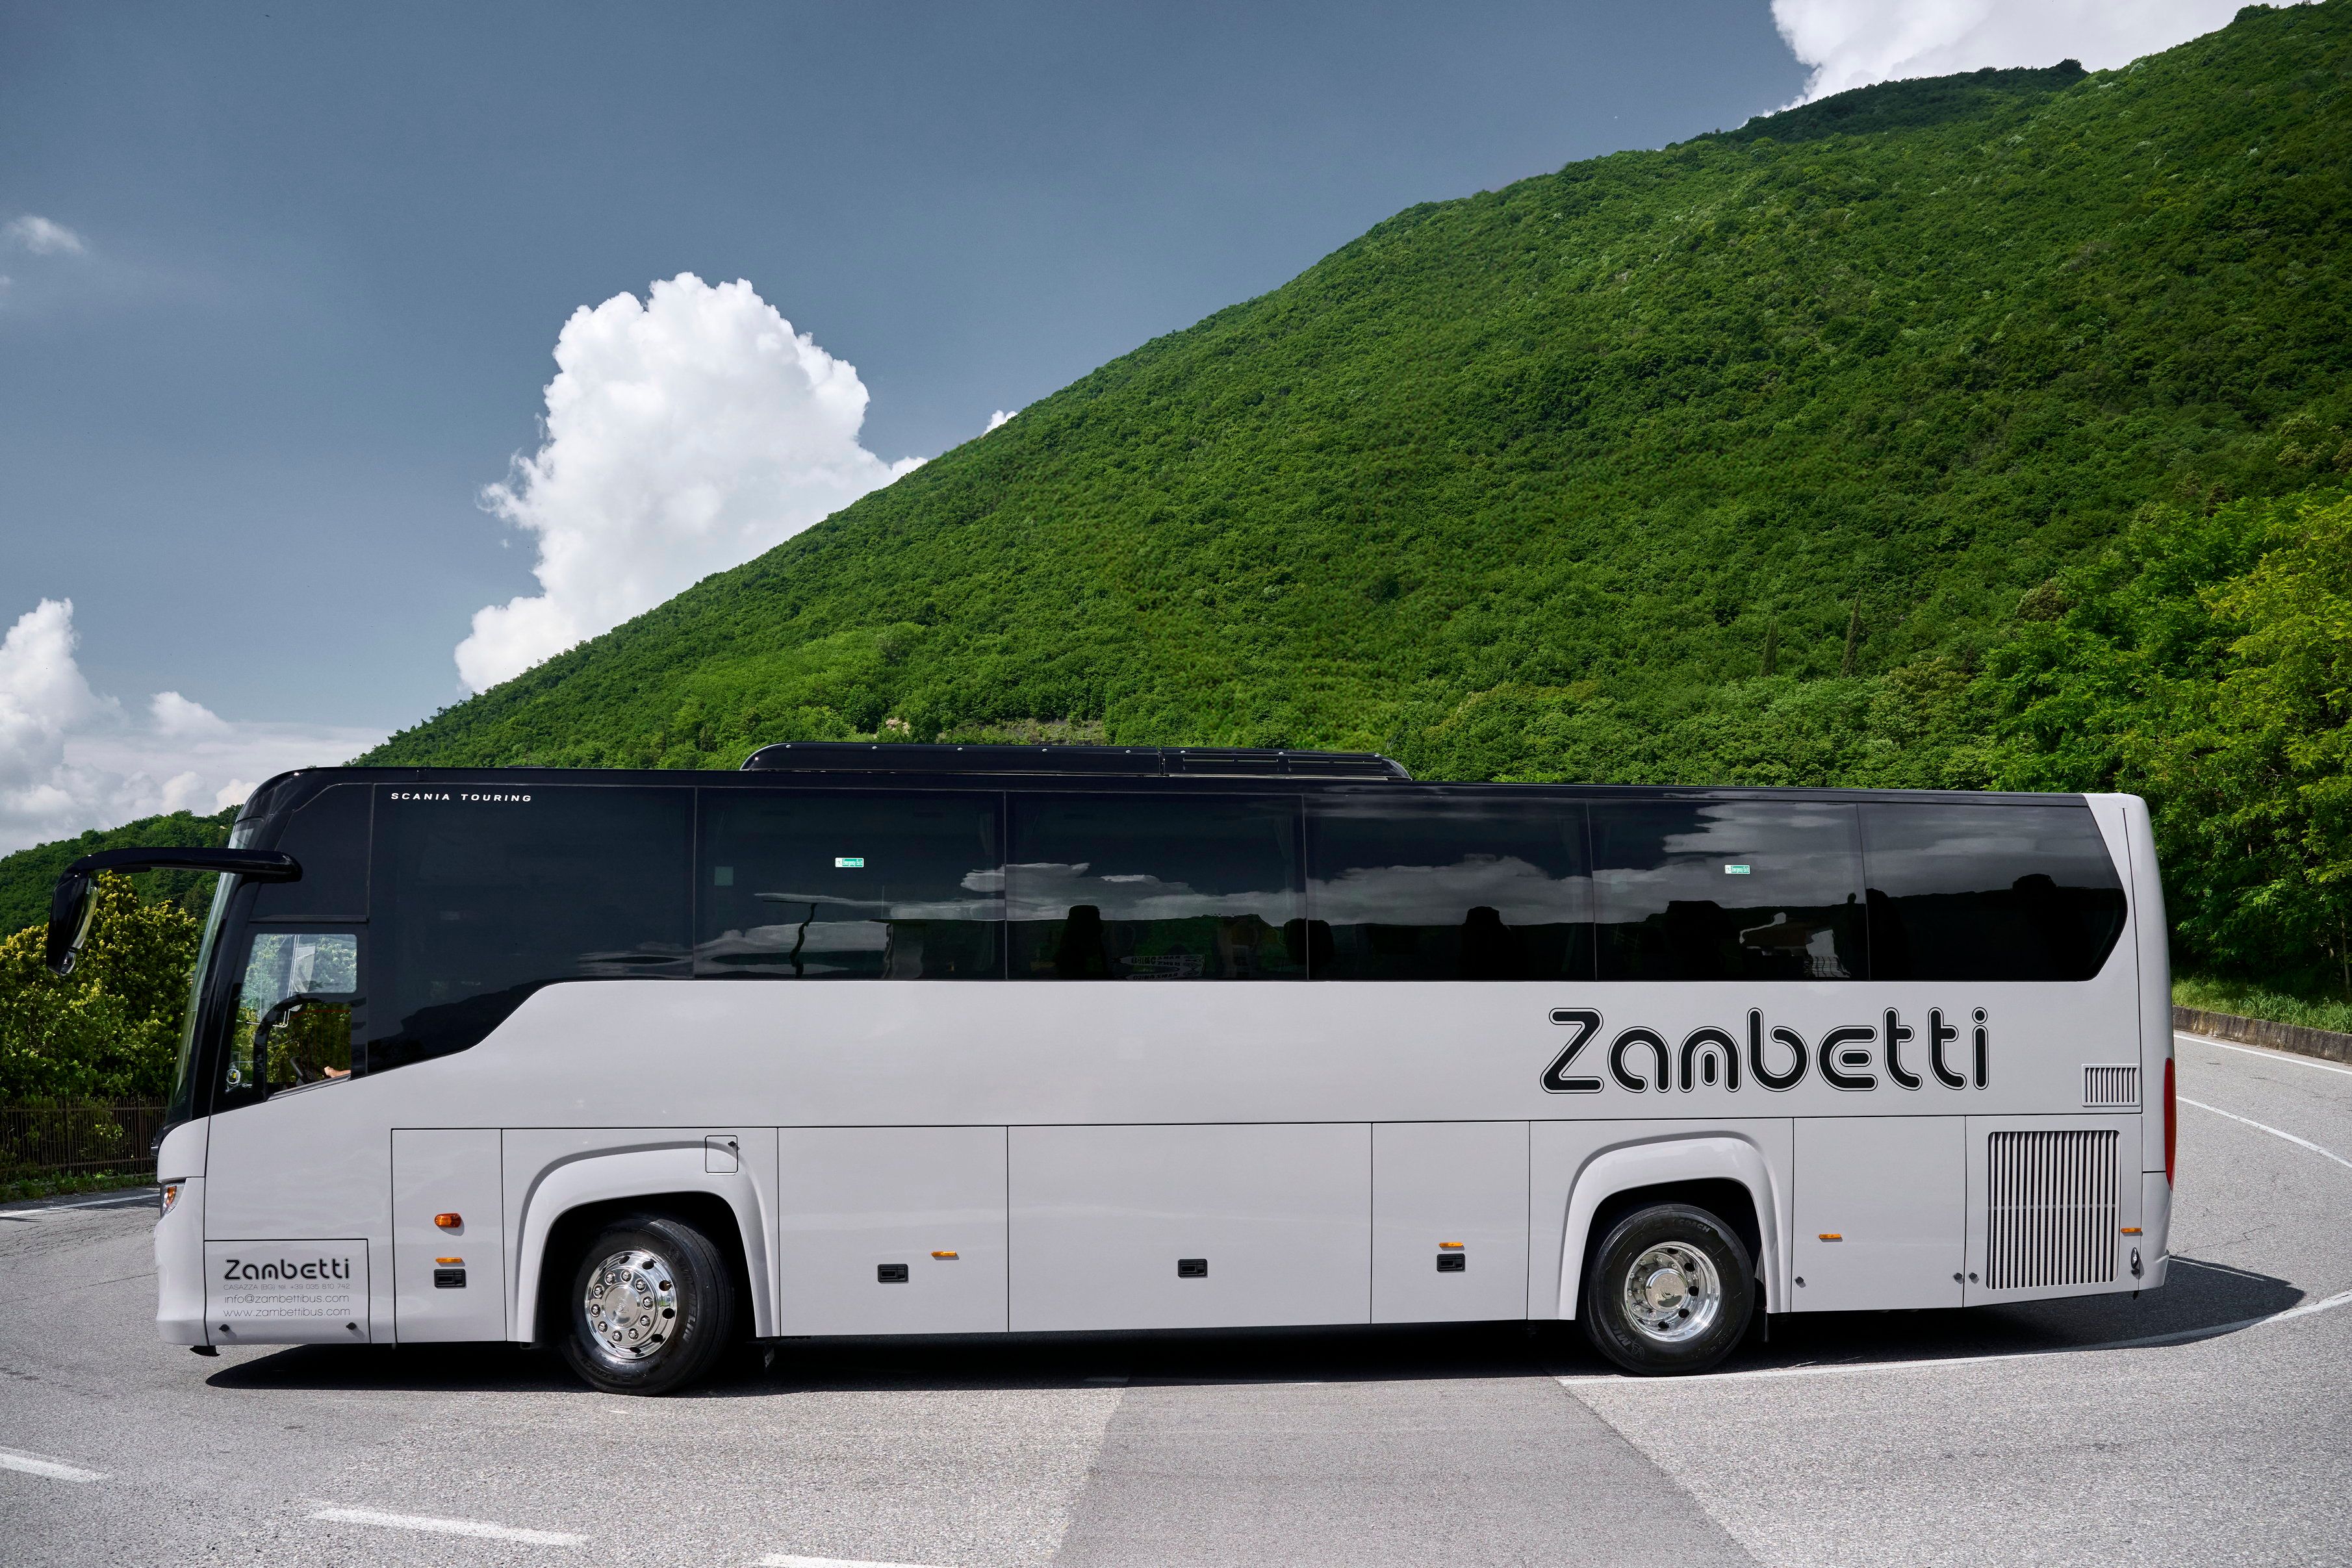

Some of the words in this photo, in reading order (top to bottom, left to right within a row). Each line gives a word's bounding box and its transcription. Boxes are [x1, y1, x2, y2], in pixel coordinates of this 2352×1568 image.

[461, 794, 531, 802] TOURING
[1540, 1007, 1989, 1094] Zambetti
[224, 1258, 350, 1280] Zambetti
[224, 1293, 350, 1304] info@zambettibus.com
[223, 1307, 350, 1317] www.zambettibus.com
